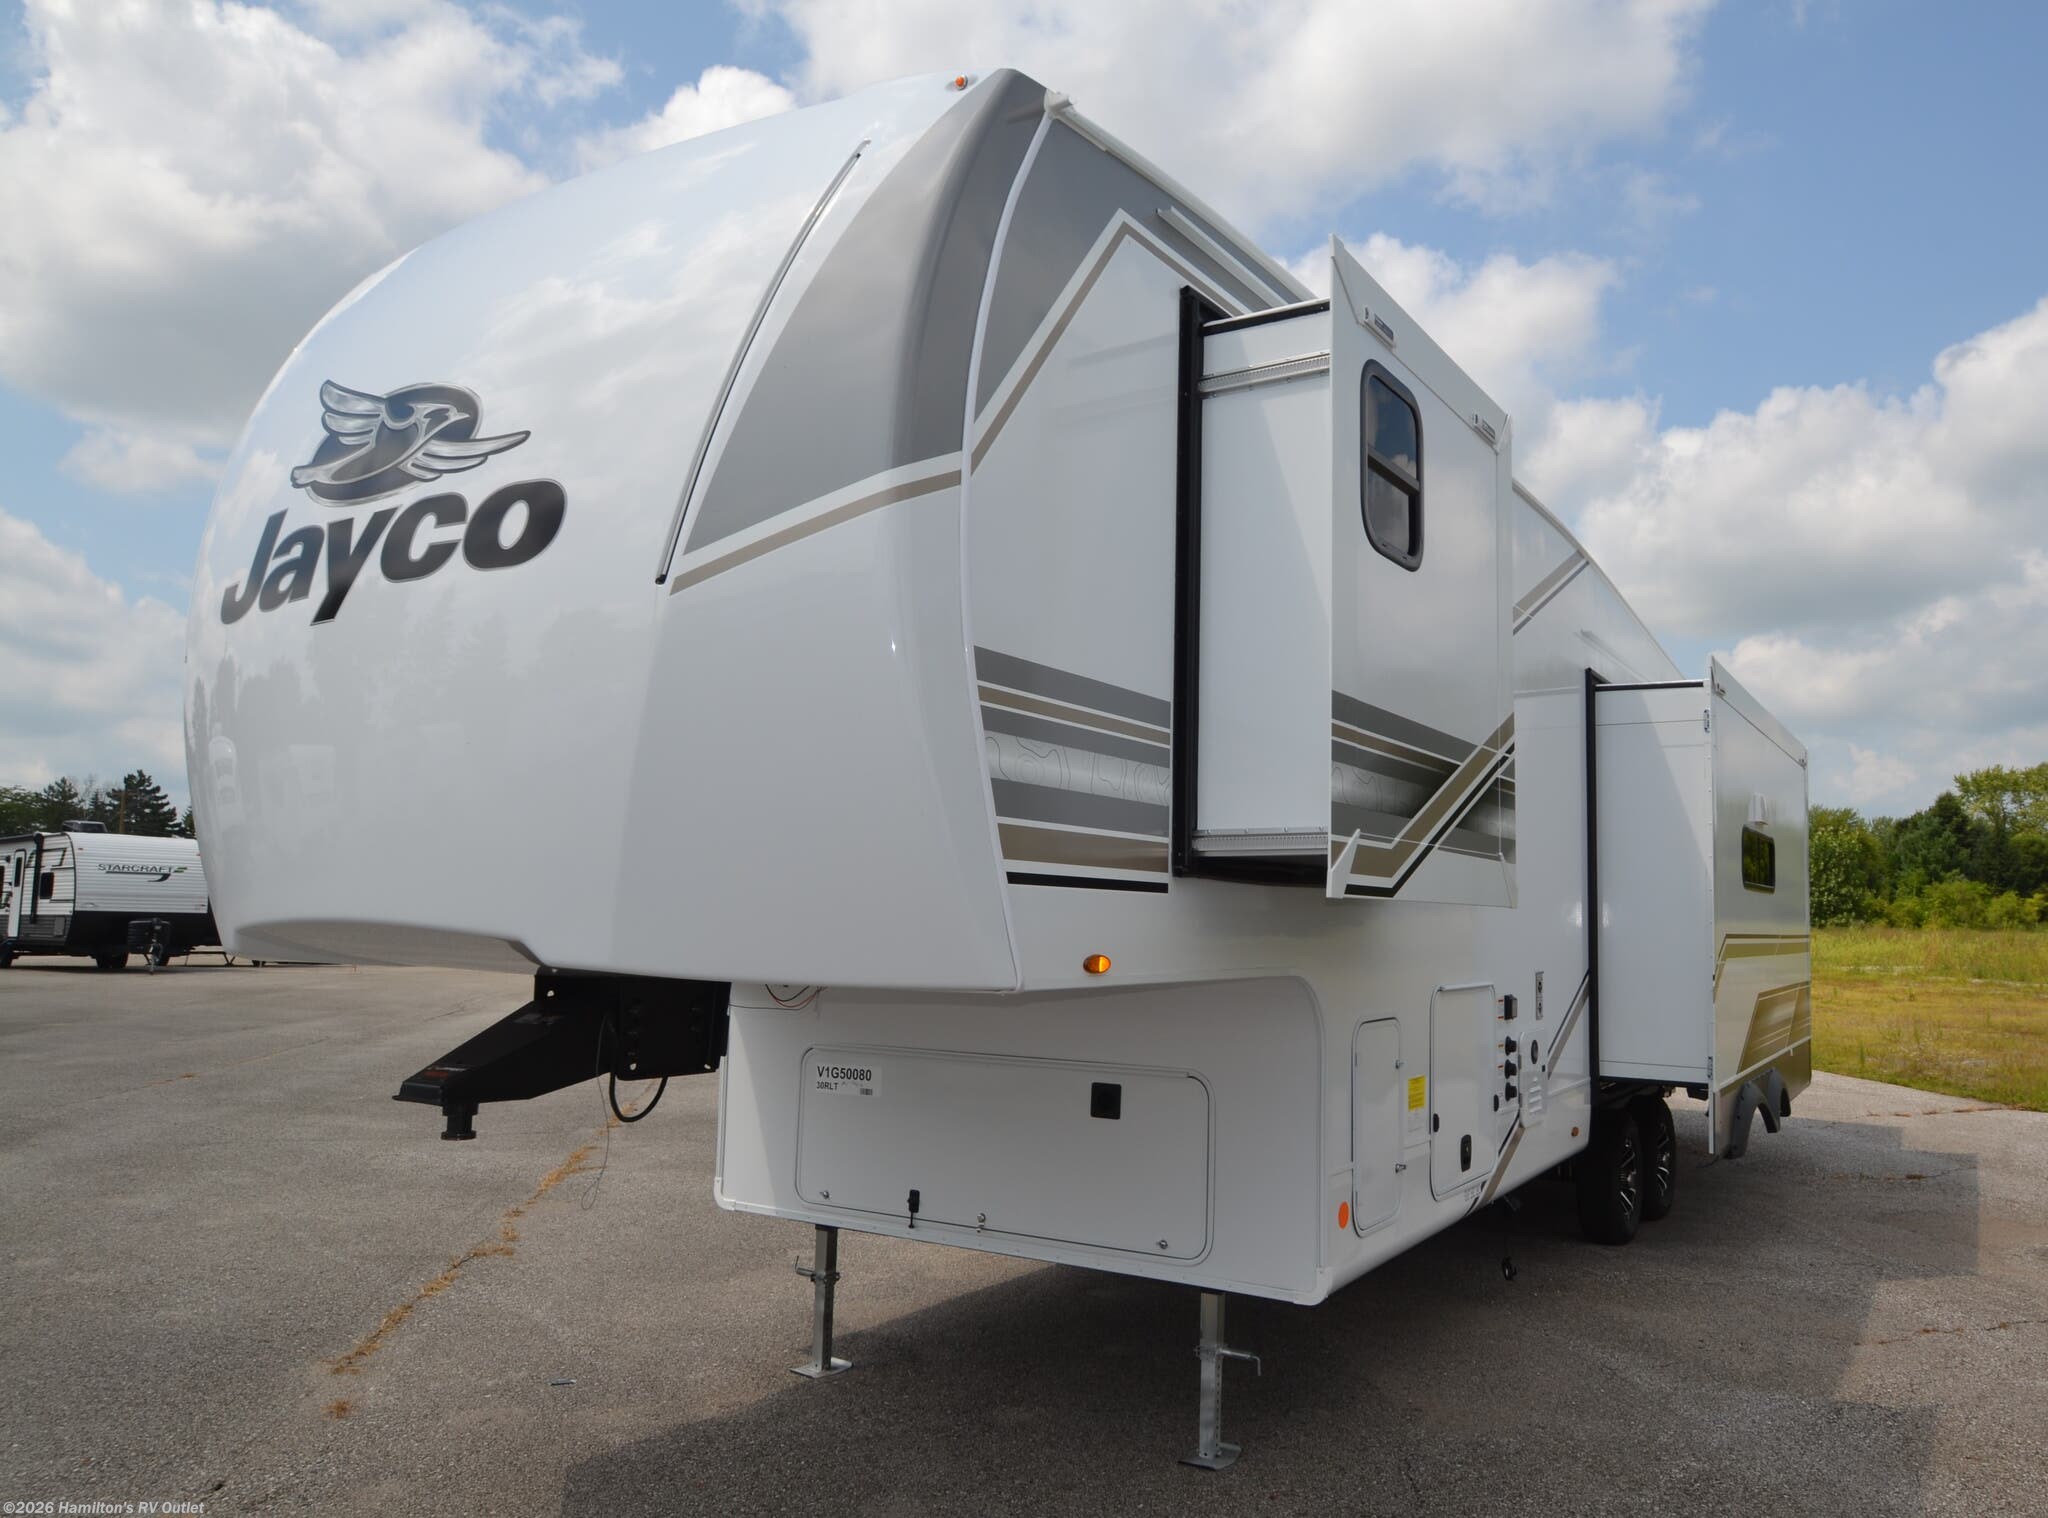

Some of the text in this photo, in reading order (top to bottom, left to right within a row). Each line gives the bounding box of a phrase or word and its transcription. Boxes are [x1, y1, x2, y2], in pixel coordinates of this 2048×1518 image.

[220, 478, 567, 626] Jayco
[98, 863, 173, 874] STARCRAFT
[816, 1065, 872, 1081] V1G50080
[816, 1081, 839, 1090] 30RLT
